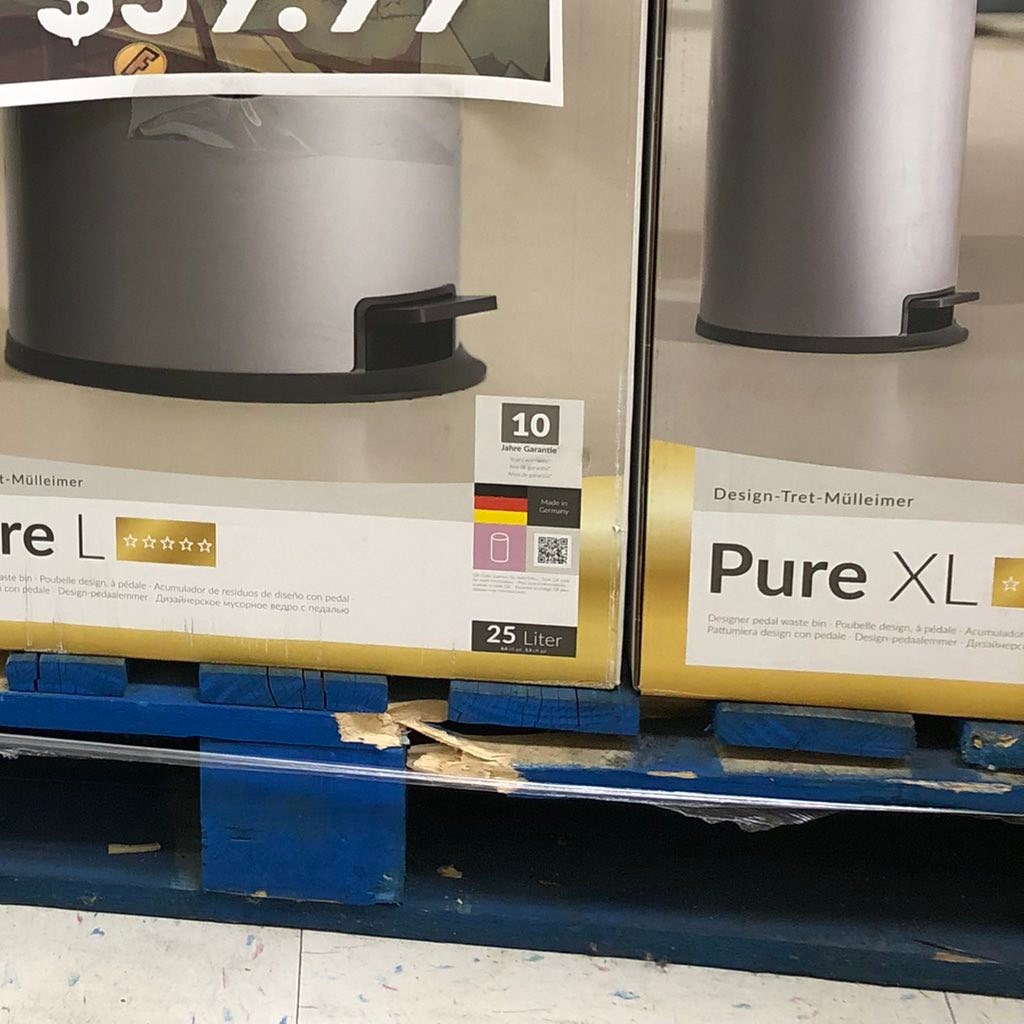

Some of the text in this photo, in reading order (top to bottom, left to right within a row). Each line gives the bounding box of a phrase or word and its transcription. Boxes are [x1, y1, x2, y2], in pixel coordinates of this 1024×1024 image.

[512, 412, 550, 437] 10
[501, 444, 521, 452] Jahre
[541, 498, 568, 506] Made in
[713, 487, 915, 509] Design-Tret-Mülleimer
[539, 507, 569, 515] Germany
[78, 513, 105, 560] L
[710, 542, 979, 607] Pure XL
[4, 585, 20, 594] con
[23, 585, 50, 596] pedale
[40, 575, 76, 585] Poubelle
[154, 582, 206, 594] Acumulador
[208, 586, 219, 595] de
[222, 587, 258, 598] residuos
[261, 589, 272, 599] de
[306, 593, 322, 602] con
[325, 593, 349, 605] pedal
[708, 614, 750, 625] Designer
[752, 616, 778, 627] pedal
[780, 618, 808, 627] waste
[812, 619, 826, 628] bin
[486, 624, 562, 648] 25 Liter
[707, 626, 758, 637] Pattumiera
[760, 628, 790, 639] design
[794, 631, 811, 639] con
[814, 631, 846, 641] pedale
